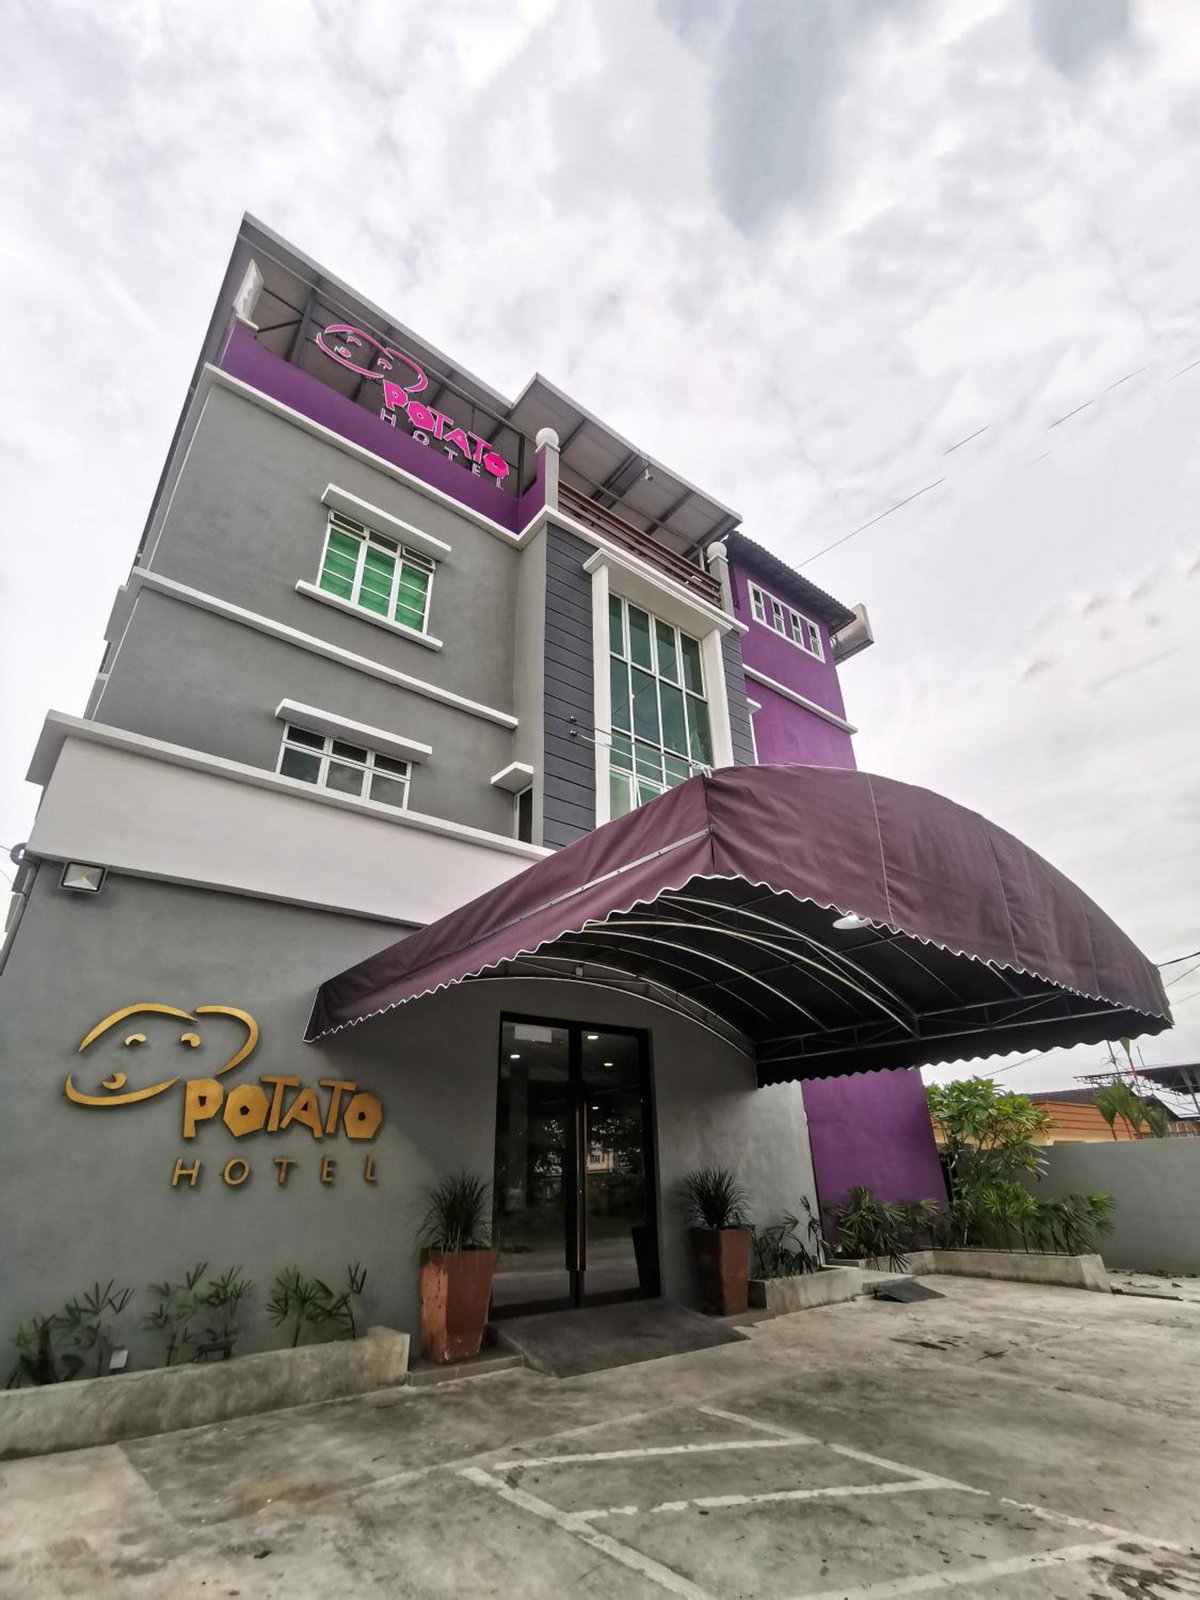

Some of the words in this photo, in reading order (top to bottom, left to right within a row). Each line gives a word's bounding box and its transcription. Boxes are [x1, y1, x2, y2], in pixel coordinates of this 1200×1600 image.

[380, 408, 504, 490] HOTEL
[383, 379, 509, 479] POTATO
[182, 1076, 383, 1139] POTATO
[171, 1155, 378, 1186] HOTEL
